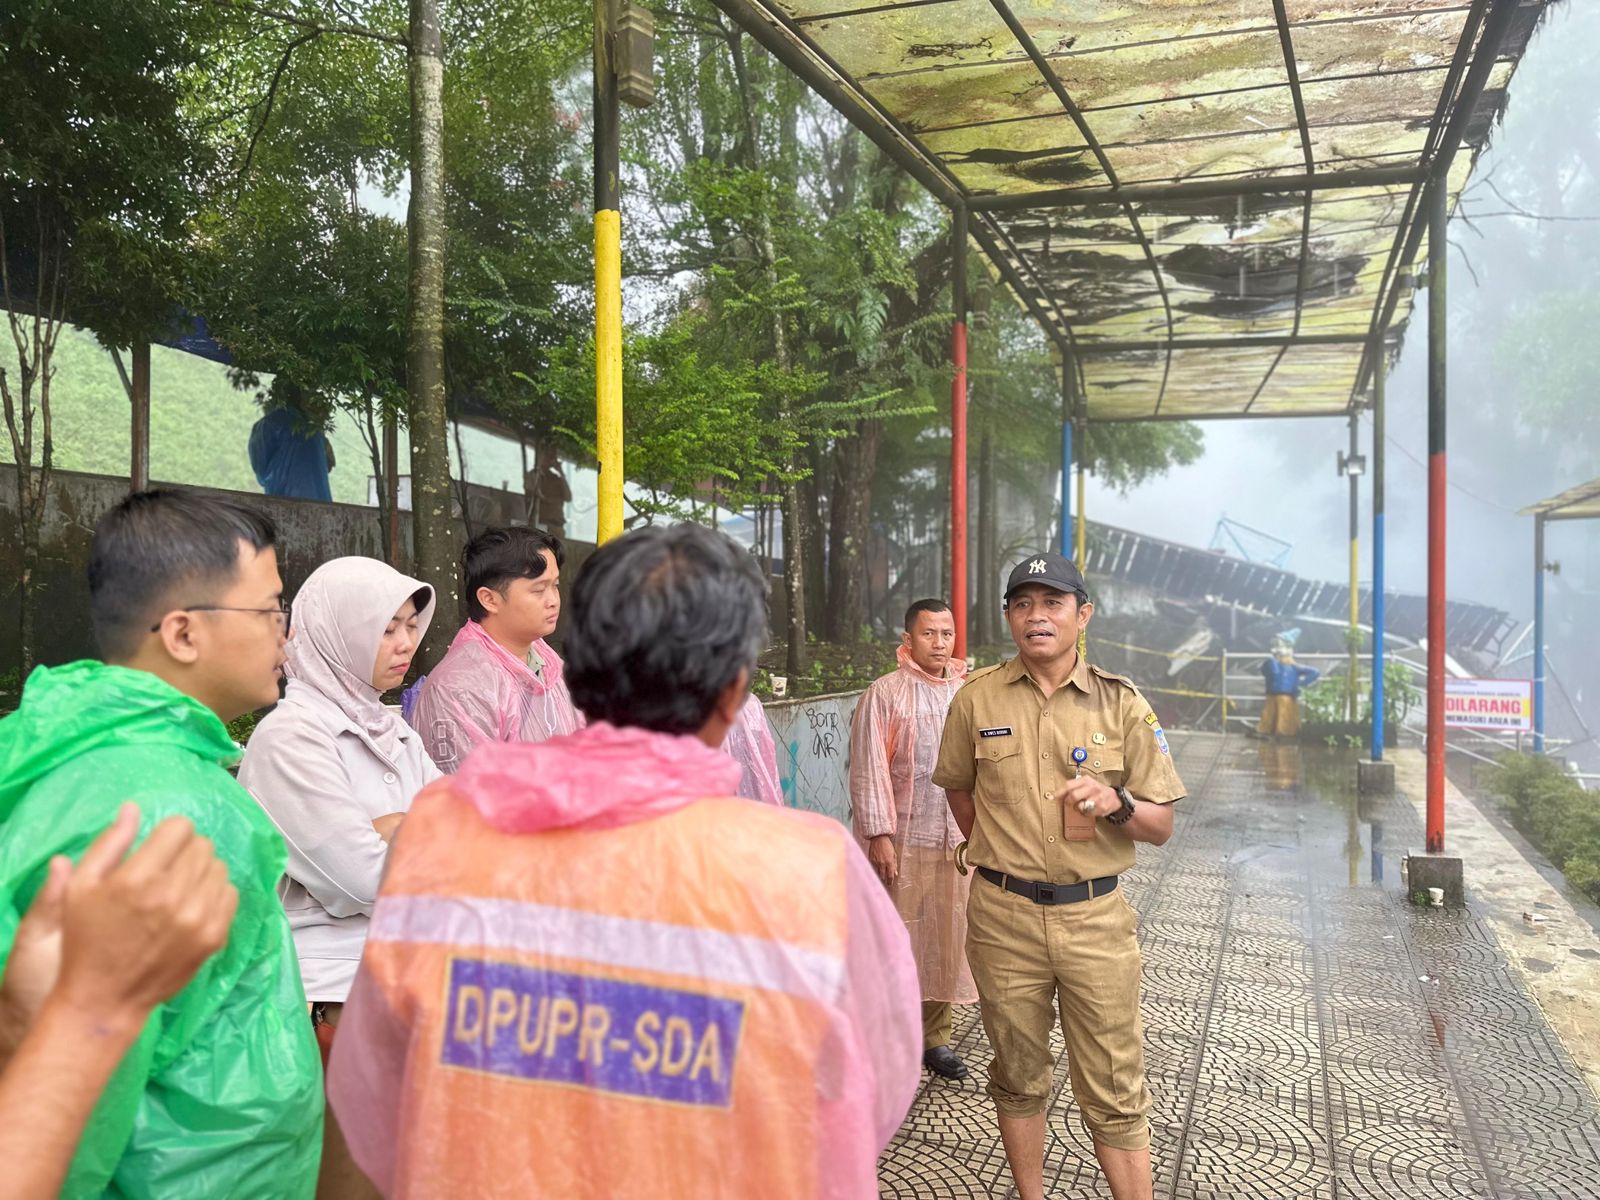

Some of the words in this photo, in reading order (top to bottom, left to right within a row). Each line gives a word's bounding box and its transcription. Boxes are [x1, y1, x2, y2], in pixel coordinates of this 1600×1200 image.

[1446, 698, 1521, 714] DILARANG
[1488, 717, 1508, 725] AREA
[454, 984, 720, 1083] DPUPR-SDA
